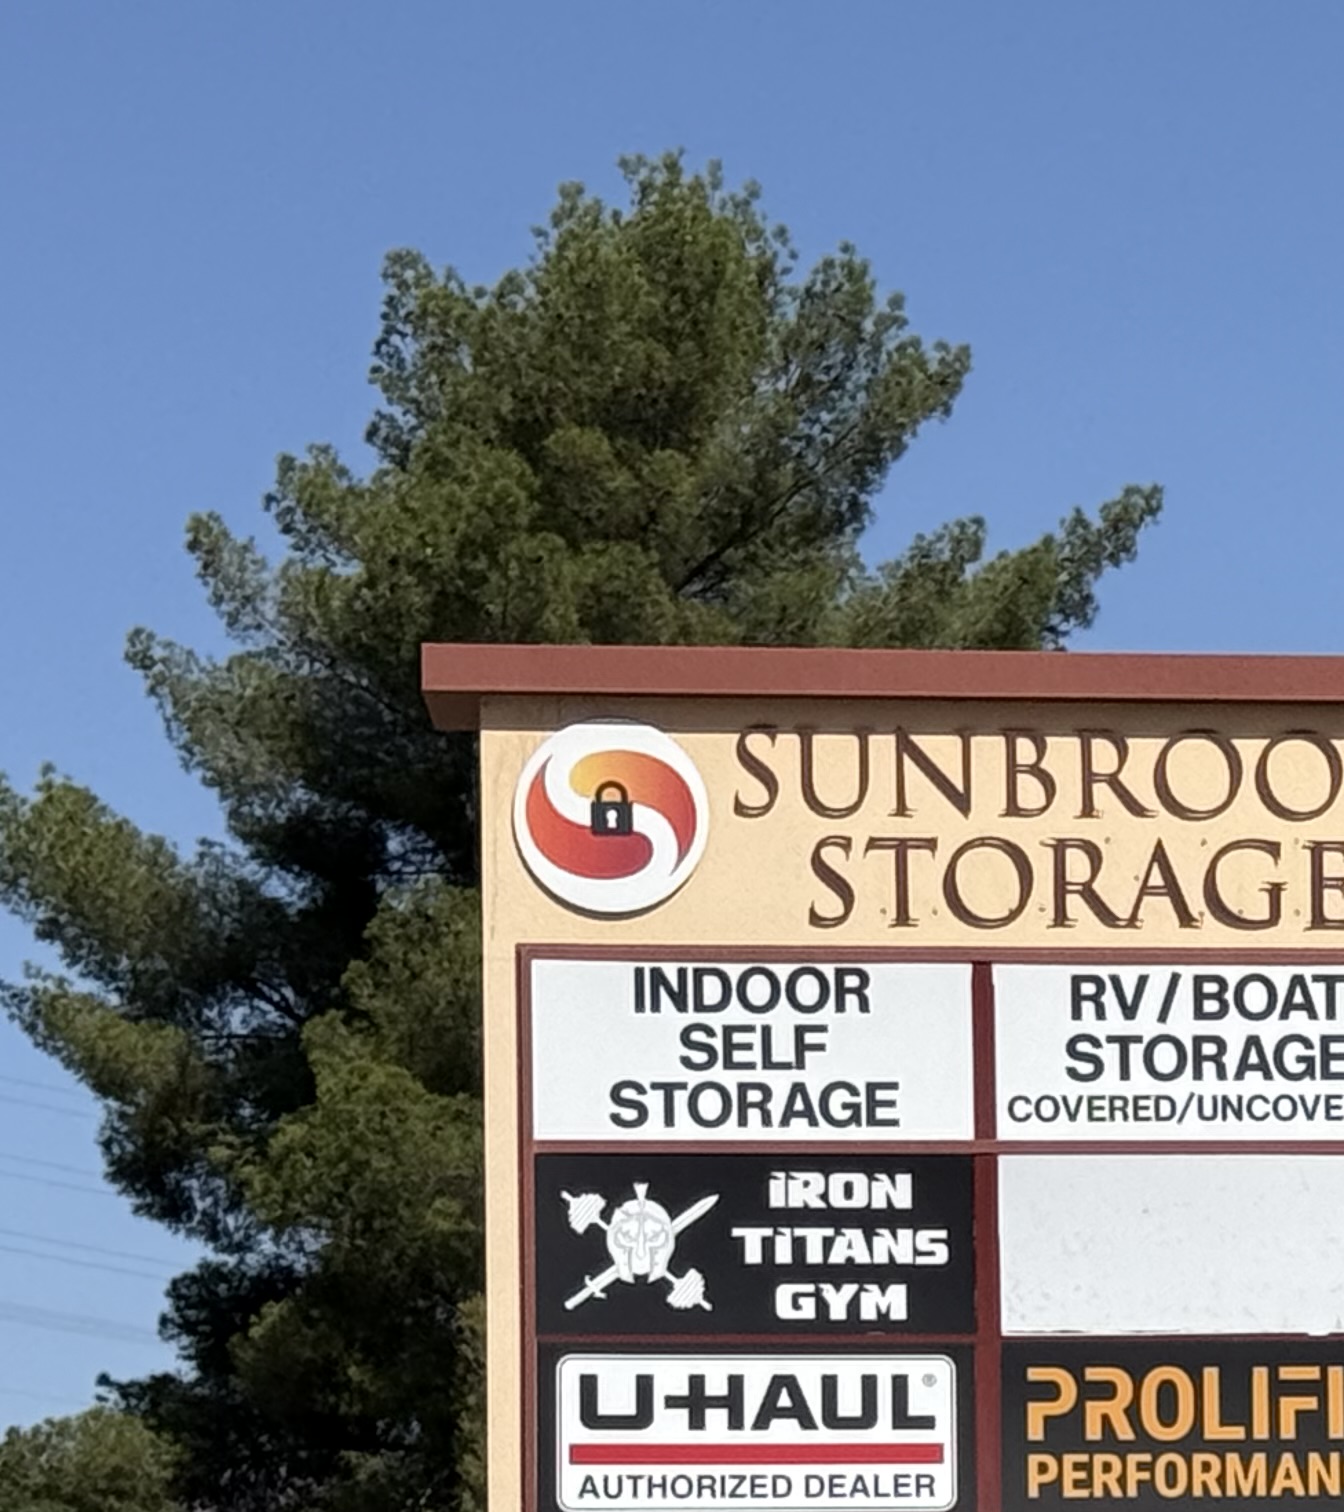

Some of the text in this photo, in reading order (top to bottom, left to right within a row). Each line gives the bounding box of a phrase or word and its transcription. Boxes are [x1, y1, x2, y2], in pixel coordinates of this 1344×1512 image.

[633, 966, 871, 1014] INDOOR
[679, 1023, 828, 1071] SELF
[609, 1080, 900, 1129] STORAGE
[769, 1172, 913, 1209] IRON
[731, 1227, 949, 1265] TITANS
[775, 1284, 908, 1321] GYM
[579, 1374, 936, 1431] U-HAUL
[578, 1473, 935, 1500] AUTHORIZED DEALER
